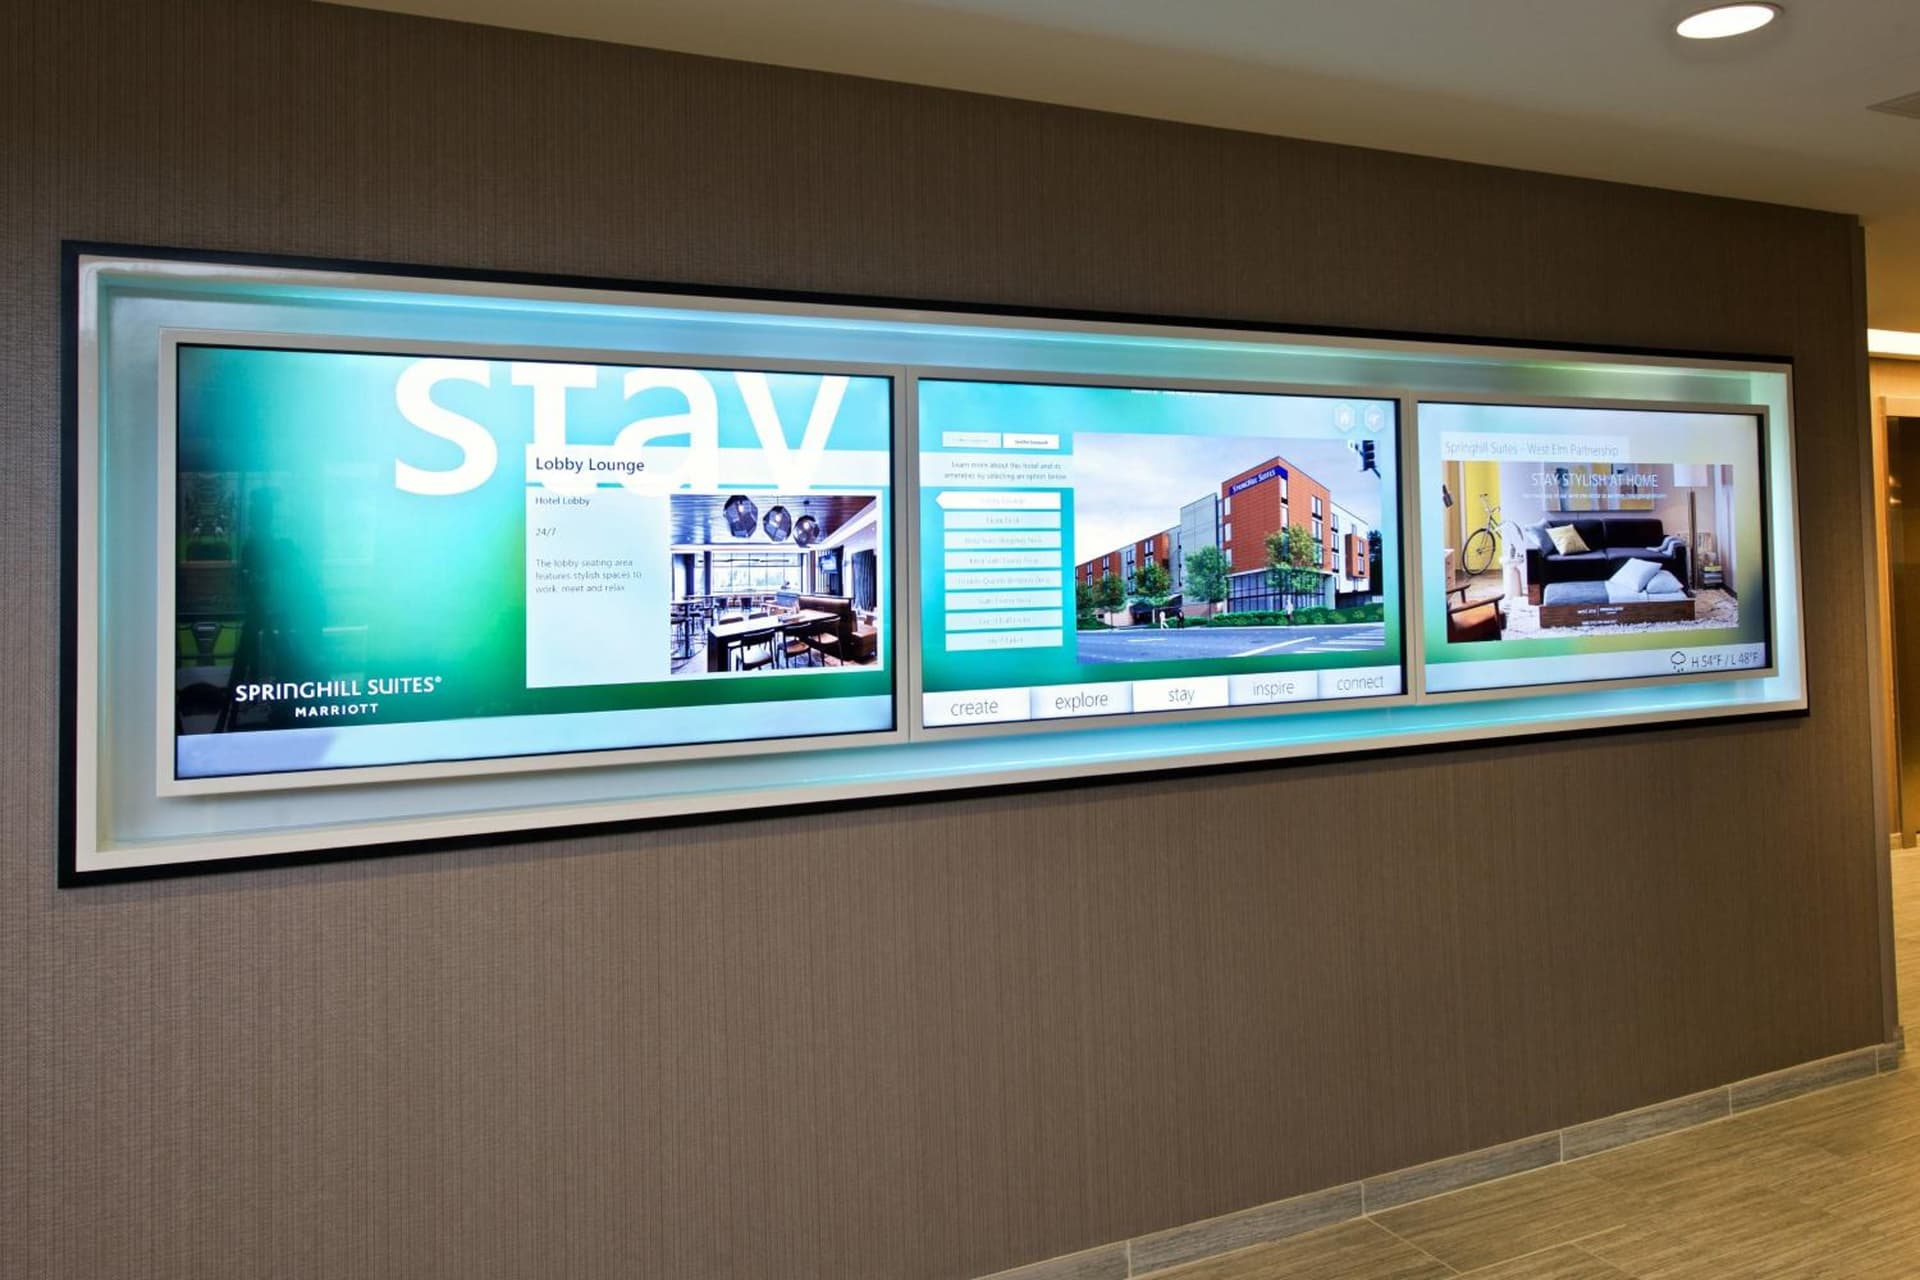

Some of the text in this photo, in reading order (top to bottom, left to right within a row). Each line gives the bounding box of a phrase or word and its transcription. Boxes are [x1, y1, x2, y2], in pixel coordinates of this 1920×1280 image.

[535, 456, 645, 475] Lobby Lounge
[1531, 473, 1659, 488] STAY STYLISH AT HOME
[535, 496, 591, 507] Hotel Lobby
[535, 527, 557, 537] 24/7
[536, 558, 552, 568] The
[554, 558, 579, 569] lobby
[582, 559, 612, 569] seating
[535, 570, 642, 581] features stylish spaces to
[586, 583, 603, 593] and
[1692, 656, 1700, 668] H
[1252, 680, 1295, 699] inspire
[1336, 675, 1385, 692] connect
[235, 681, 362, 702] SPRINGHILL
[1168, 686, 1196, 705] stay
[950, 699, 999, 717] create
[1055, 692, 1109, 711] explore
[294, 703, 379, 718] MARRIOTT
